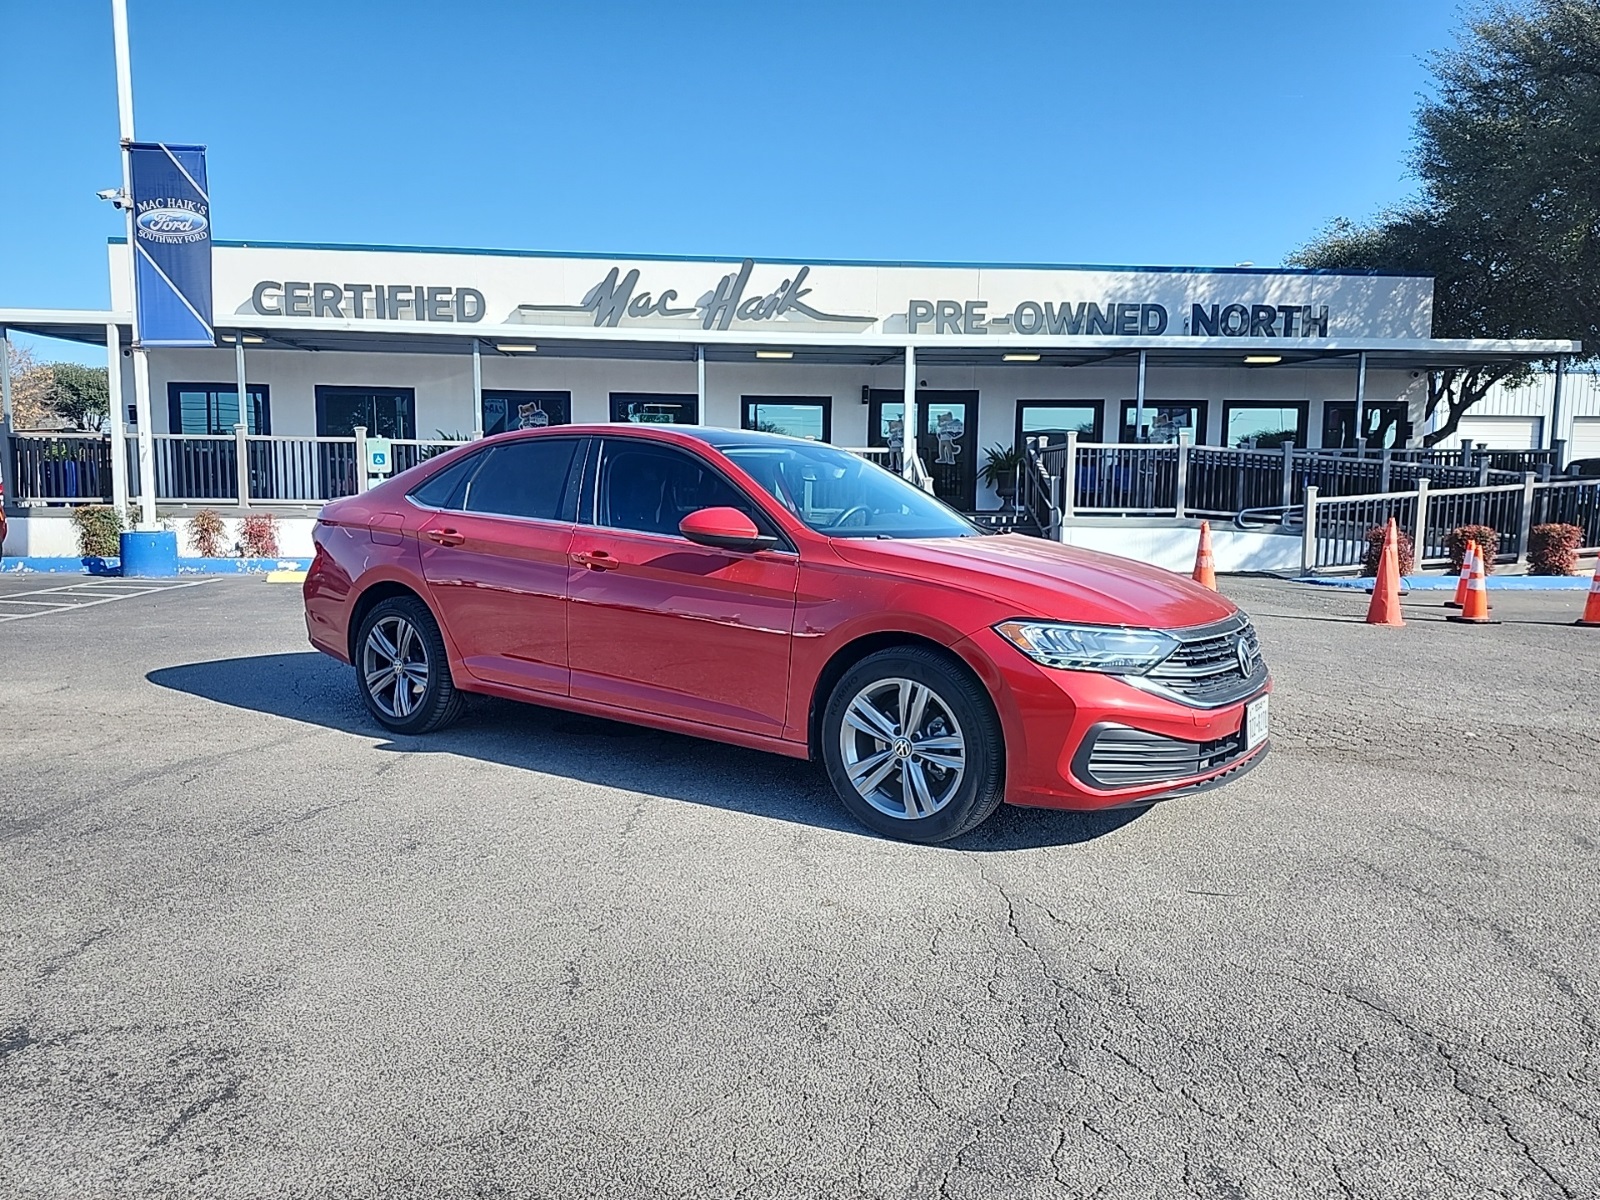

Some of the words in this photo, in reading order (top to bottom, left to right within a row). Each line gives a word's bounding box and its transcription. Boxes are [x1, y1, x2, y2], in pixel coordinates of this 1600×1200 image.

[137, 198, 164, 212] MAC
[167, 198, 207, 215] HAIK'S
[150, 213, 193, 231] Ford
[138, 229, 183, 244] SOUTHWAY
[185, 231, 208, 244] FORD
[252, 280, 487, 323] CERTIFIED
[518, 267, 697, 328] Mac
[697, 258, 879, 331] Haik
[908, 299, 1168, 337] PRE-OWNED
[1191, 303, 1329, 338] NORTH
[830, 676, 858, 716] KUMHO
